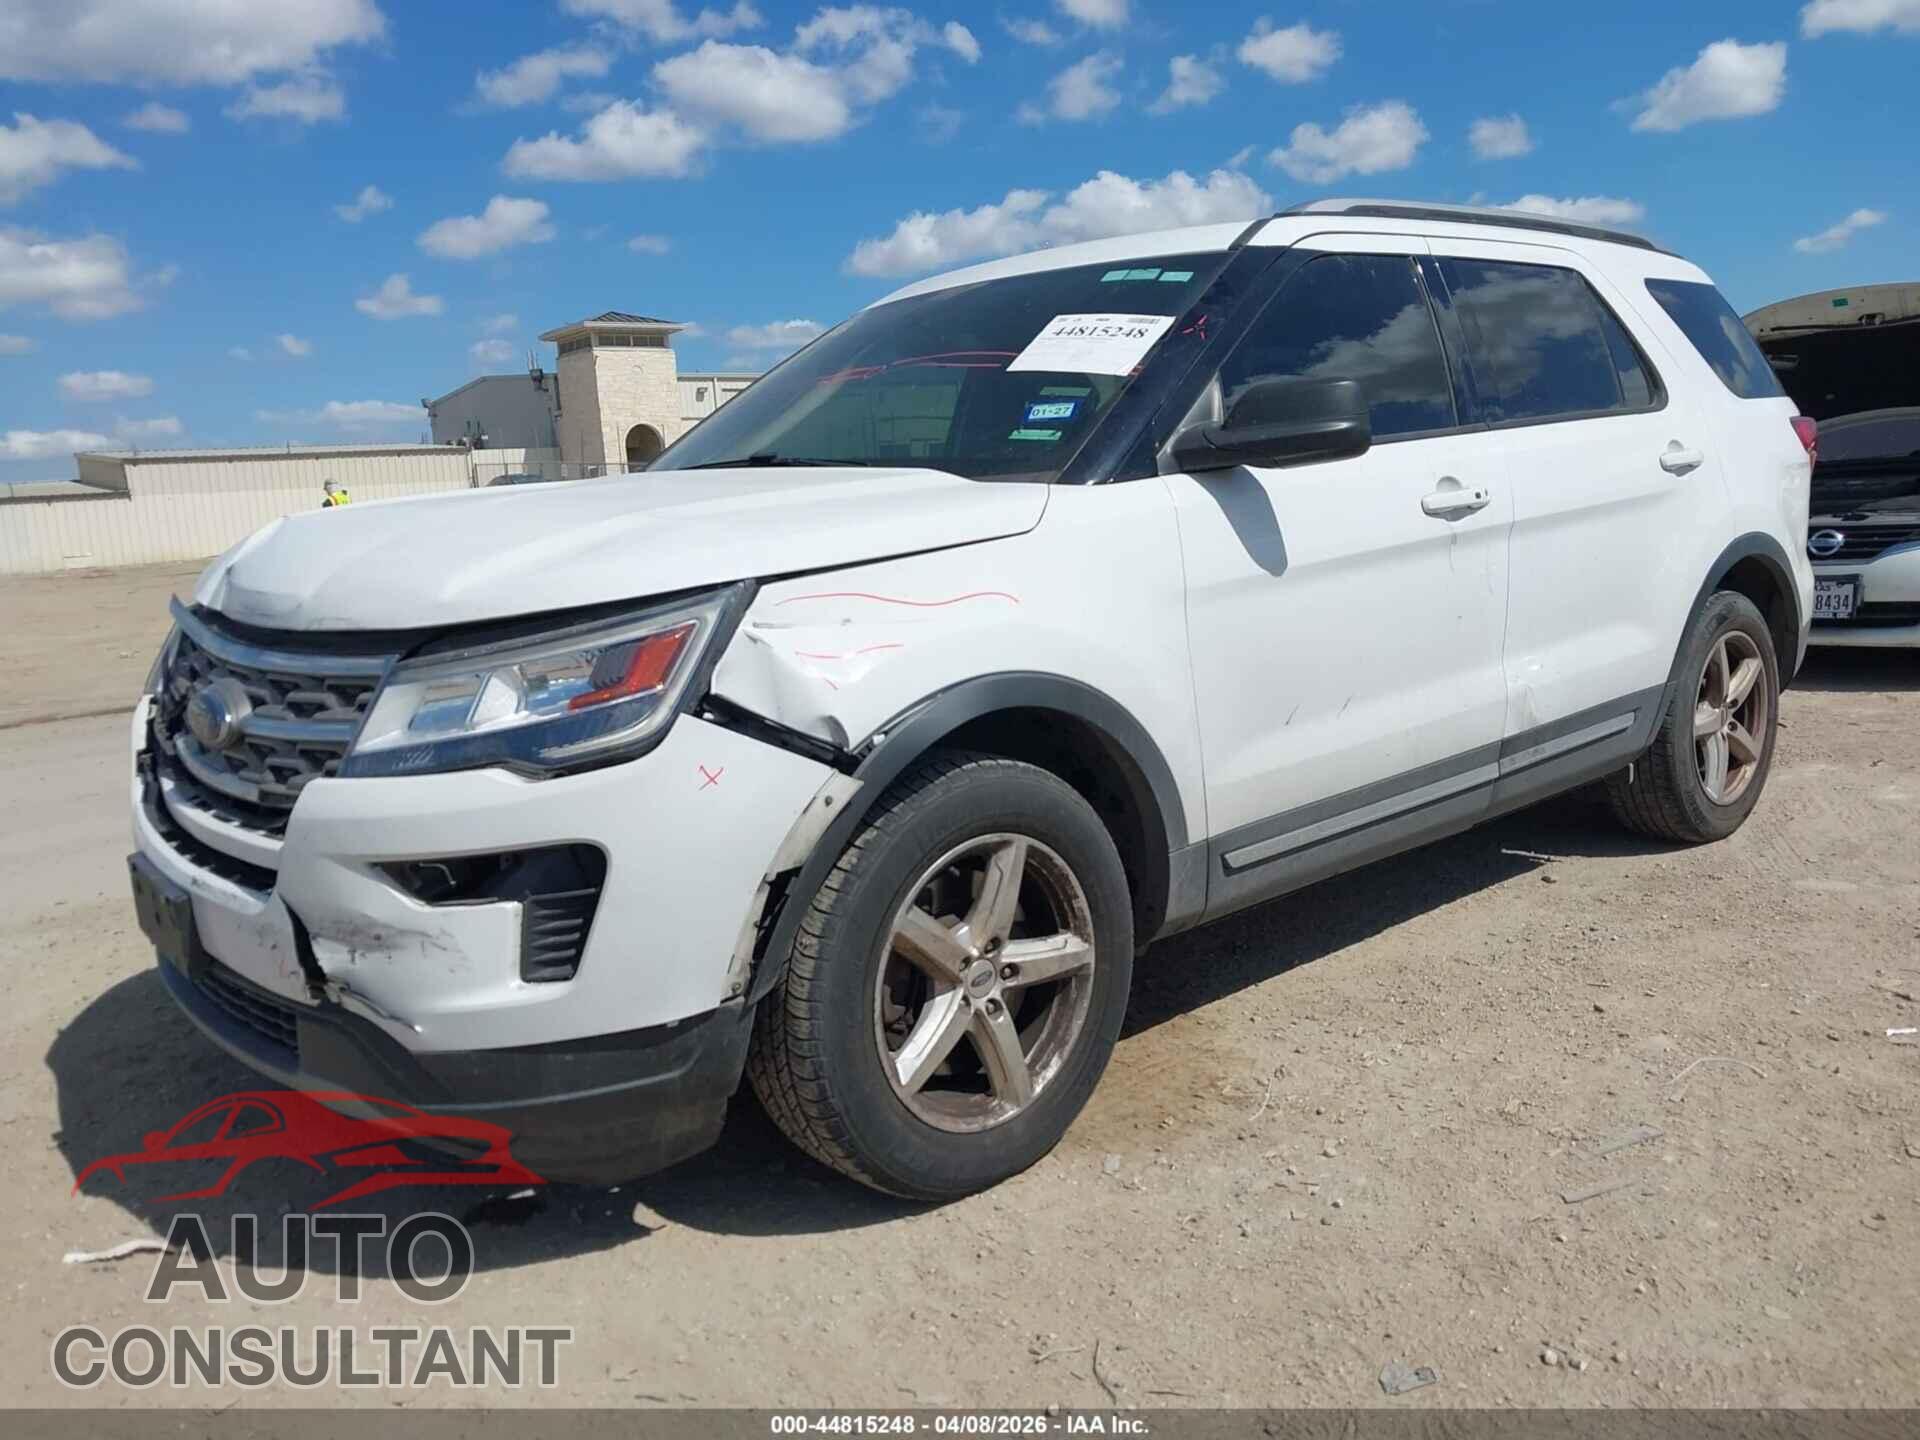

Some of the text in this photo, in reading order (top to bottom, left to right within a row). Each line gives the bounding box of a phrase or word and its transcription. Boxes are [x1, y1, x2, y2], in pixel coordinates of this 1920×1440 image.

[1052, 326, 1149, 339] 44815248
[1032, 406, 1070, 417] 01-27
[1815, 594, 1849, 610] 8434
